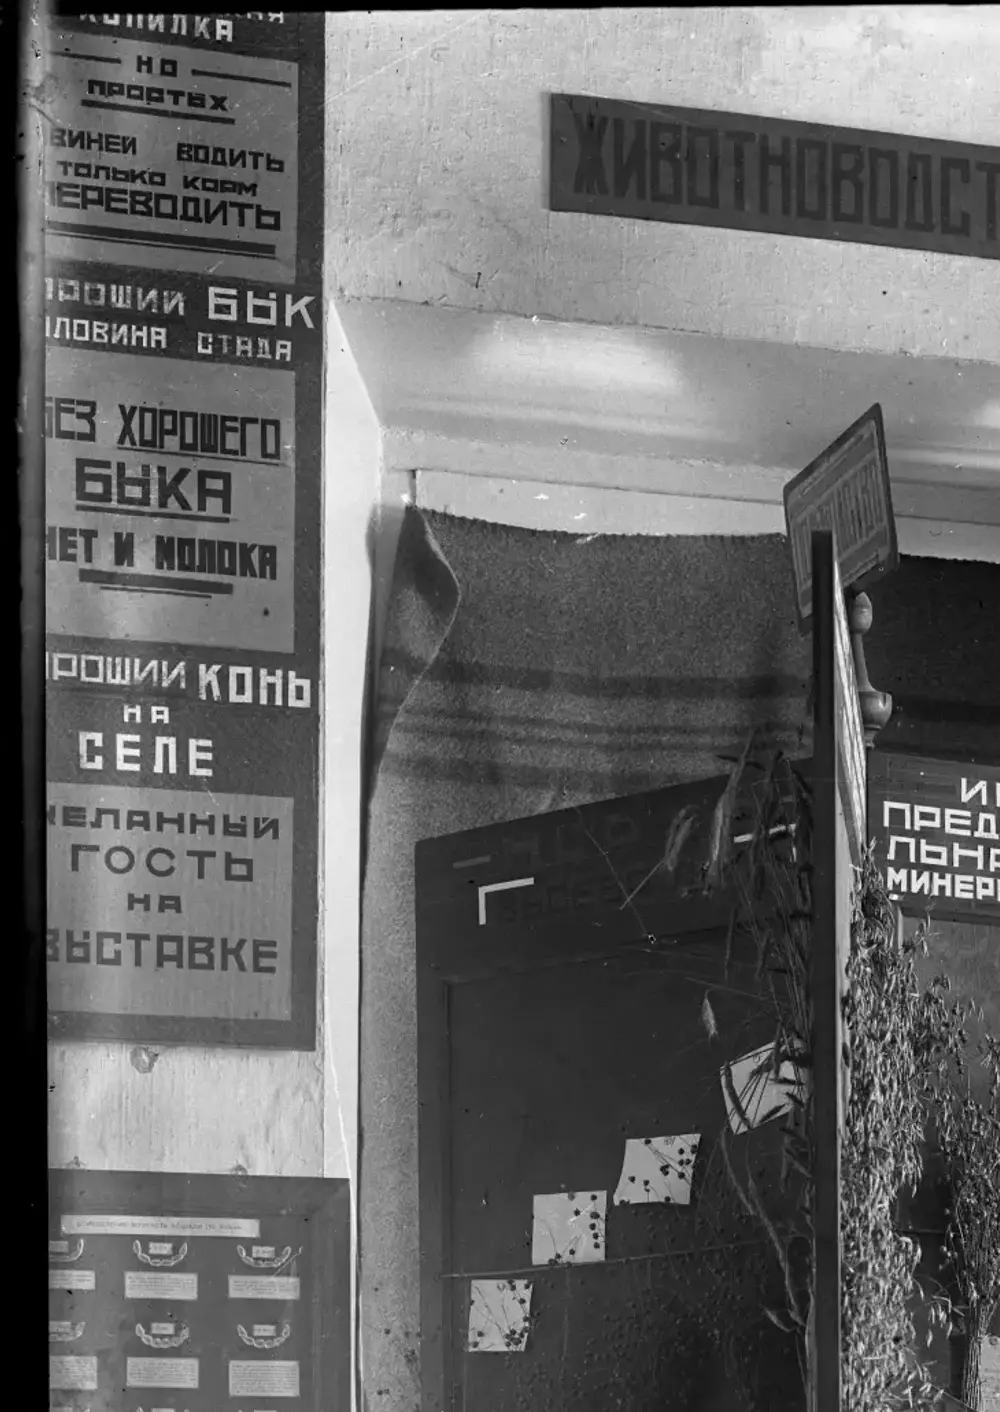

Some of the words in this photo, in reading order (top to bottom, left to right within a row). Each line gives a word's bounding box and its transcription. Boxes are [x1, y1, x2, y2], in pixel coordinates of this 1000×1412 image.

[137, 55, 178, 78] НО
[88, 79, 228, 112] ПРОСТЫХ
[176, 142, 285, 173] ВОДИТЬ
[56, 160, 166, 187] ТОЛЬКО
[183, 174, 258, 198] КОРМ
[207, 286, 316, 329] БЫК
[45, 316, 168, 349] ЛОВИНА
[197, 332, 292, 362] СТАДА
[117, 403, 282, 460] ХОРОШЕГО
[75, 457, 232, 516] БЫКА
[114, 532, 135, 567] И
[155, 535, 278, 581] МОЛОКА
[198, 664, 312, 709] КОНЬ
[123, 704, 170, 725] НА
[78, 731, 213, 777] СЕЛЕ
[70, 844, 254, 883] ГОСТЬ
[127, 892, 183, 915] НА
